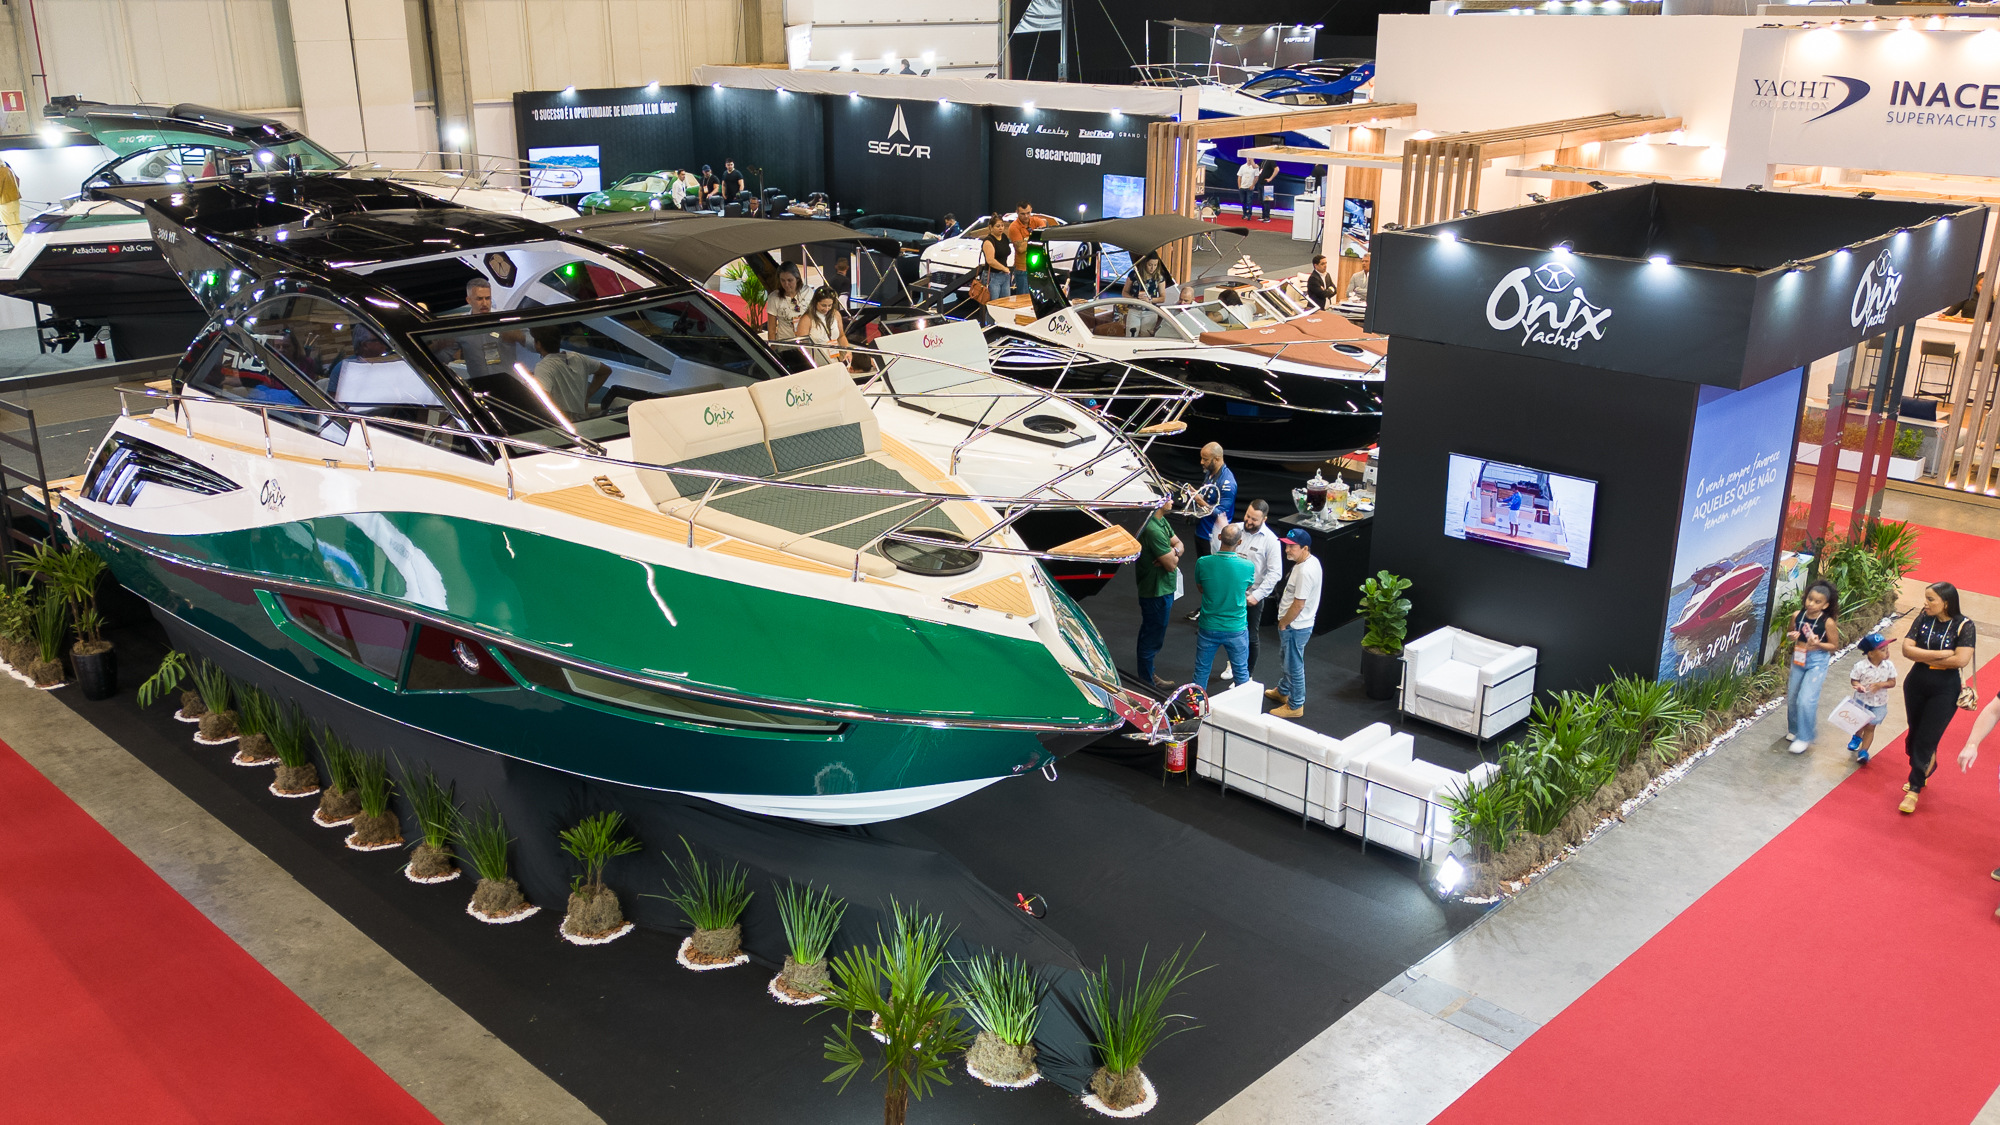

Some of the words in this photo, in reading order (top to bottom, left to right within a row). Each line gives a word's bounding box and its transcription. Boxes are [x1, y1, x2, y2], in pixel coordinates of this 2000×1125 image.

[1753, 79, 1836, 99] YACHT
[1890, 80, 2000, 110] INACE
[540, 107, 564, 121] SUCESSO
[574, 105, 613, 119] OPORTUNIDADE
[613, 105, 620, 118] DE
[1750, 99, 1831, 112] COLLECTION
[1886, 110, 1998, 128] SUPERYACHTS
[1118, 131, 1141, 139] GRAND
[868, 140, 931, 160] SEACAR
[1035, 147, 1102, 166] seacarcompany
[1486, 266, 1612, 341] Onix
[1851, 260, 1902, 328] Onix
[1048, 316, 1073, 333] Onix
[1521, 318, 1583, 351] Yachts
[923, 334, 944, 348] Onix
[785, 388, 813, 408] Onix
[704, 407, 734, 426] Onix
[1696, 478, 1705, 499] O
[1725, 464, 1751, 487] sempre
[260, 480, 286, 508] Onix
[1691, 487, 1736, 522] AQUELES
[1737, 477, 1757, 501] QUE
[1757, 467, 1777, 490] NÃO
[1679, 648, 1704, 677] Onix
